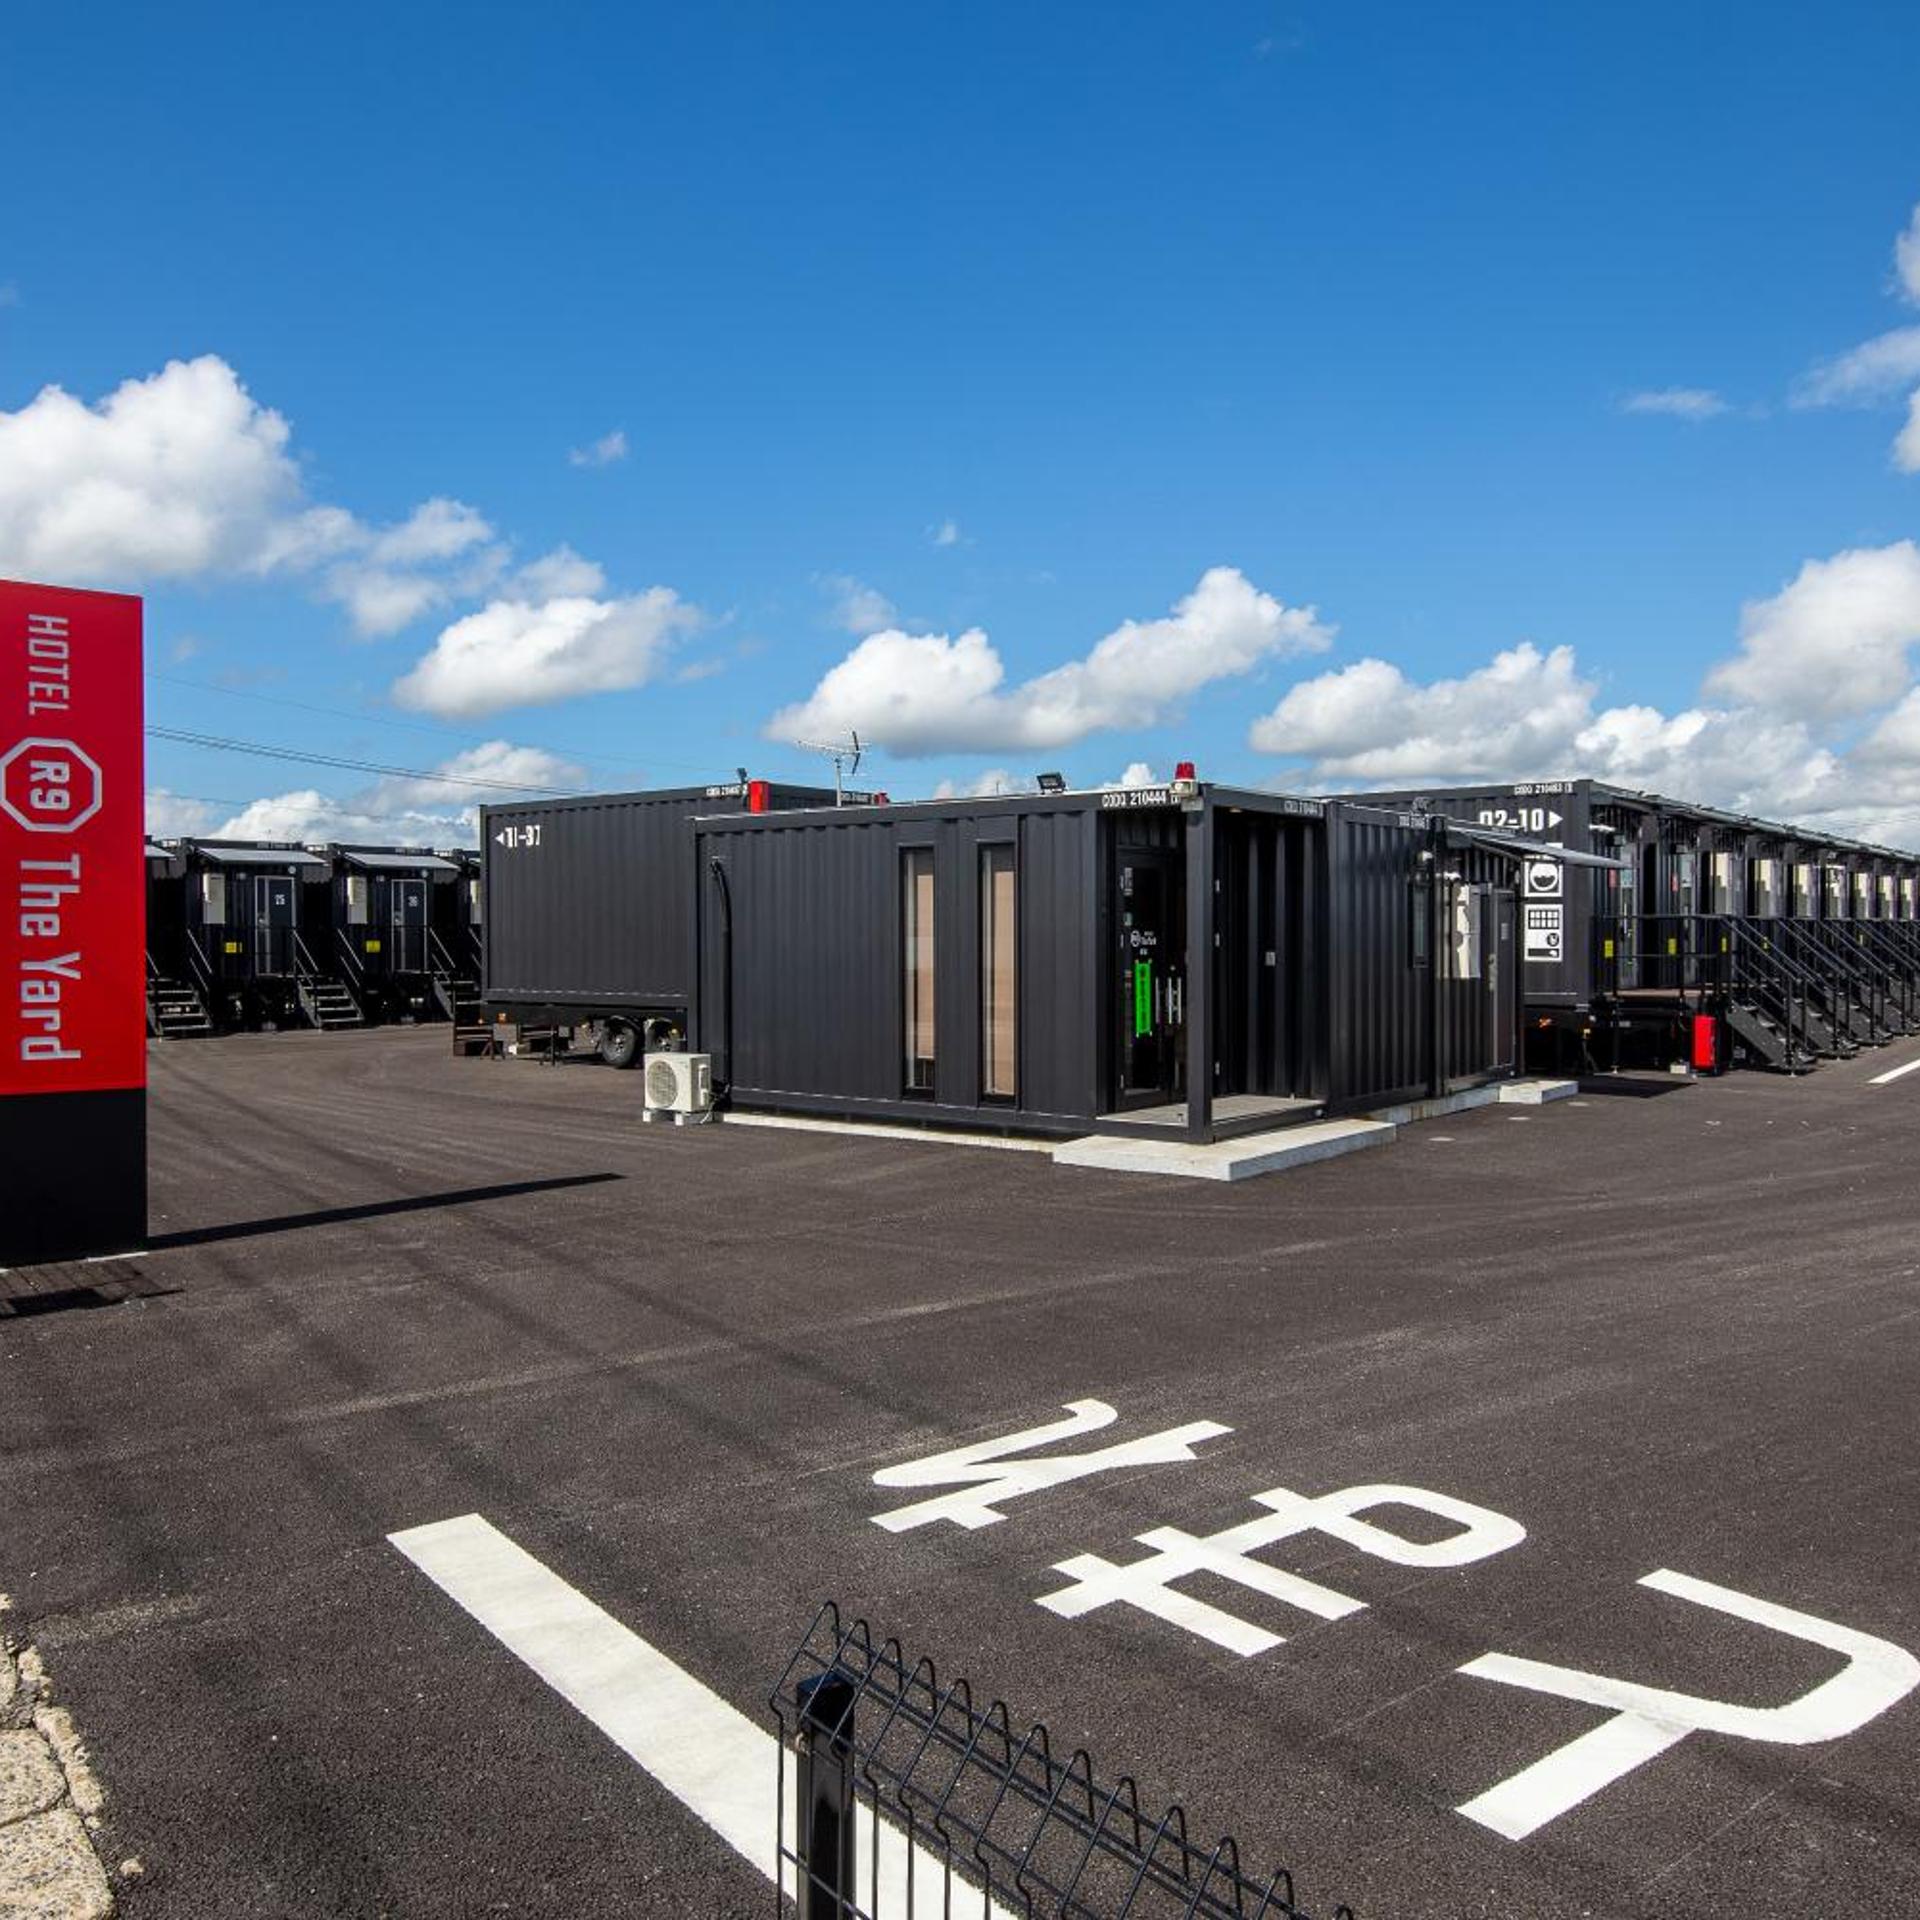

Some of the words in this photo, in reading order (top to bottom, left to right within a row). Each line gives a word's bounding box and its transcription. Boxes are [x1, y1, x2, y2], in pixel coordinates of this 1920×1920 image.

[28, 613, 70, 715] HOTEL
[29, 759, 71, 811] R9
[20, 853, 81, 937] The
[20, 951, 82, 1061] Yard
